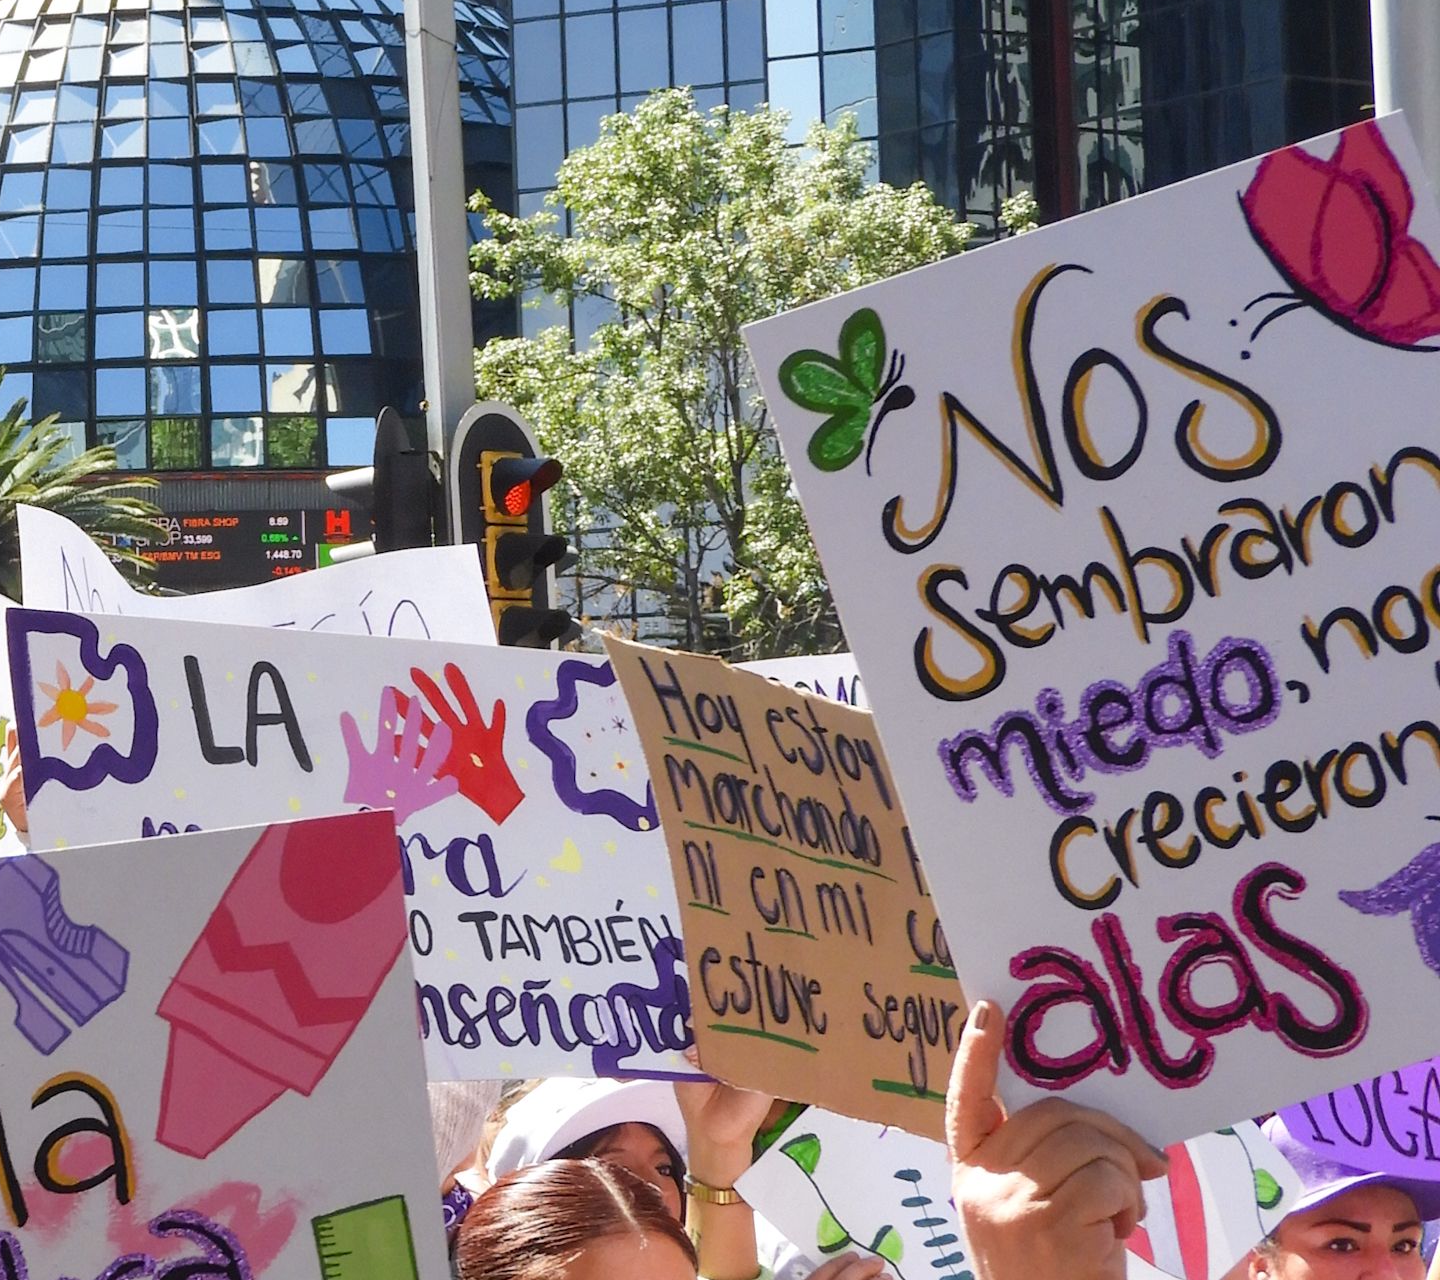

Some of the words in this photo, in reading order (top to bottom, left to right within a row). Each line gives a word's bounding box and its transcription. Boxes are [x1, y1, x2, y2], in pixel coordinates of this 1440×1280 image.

[882, 261, 1283, 554] NOS
[1301, 563, 1440, 690] no
[184, 654, 313, 772] LA
[638, 656, 758, 773] Hoy
[764, 699, 894, 811] estoy
[458, 900, 681, 966] TAMBIÉN
[1003, 862, 1368, 1091] alas
[699, 931, 827, 1035] estuve
[863, 980, 965, 1096] segur
